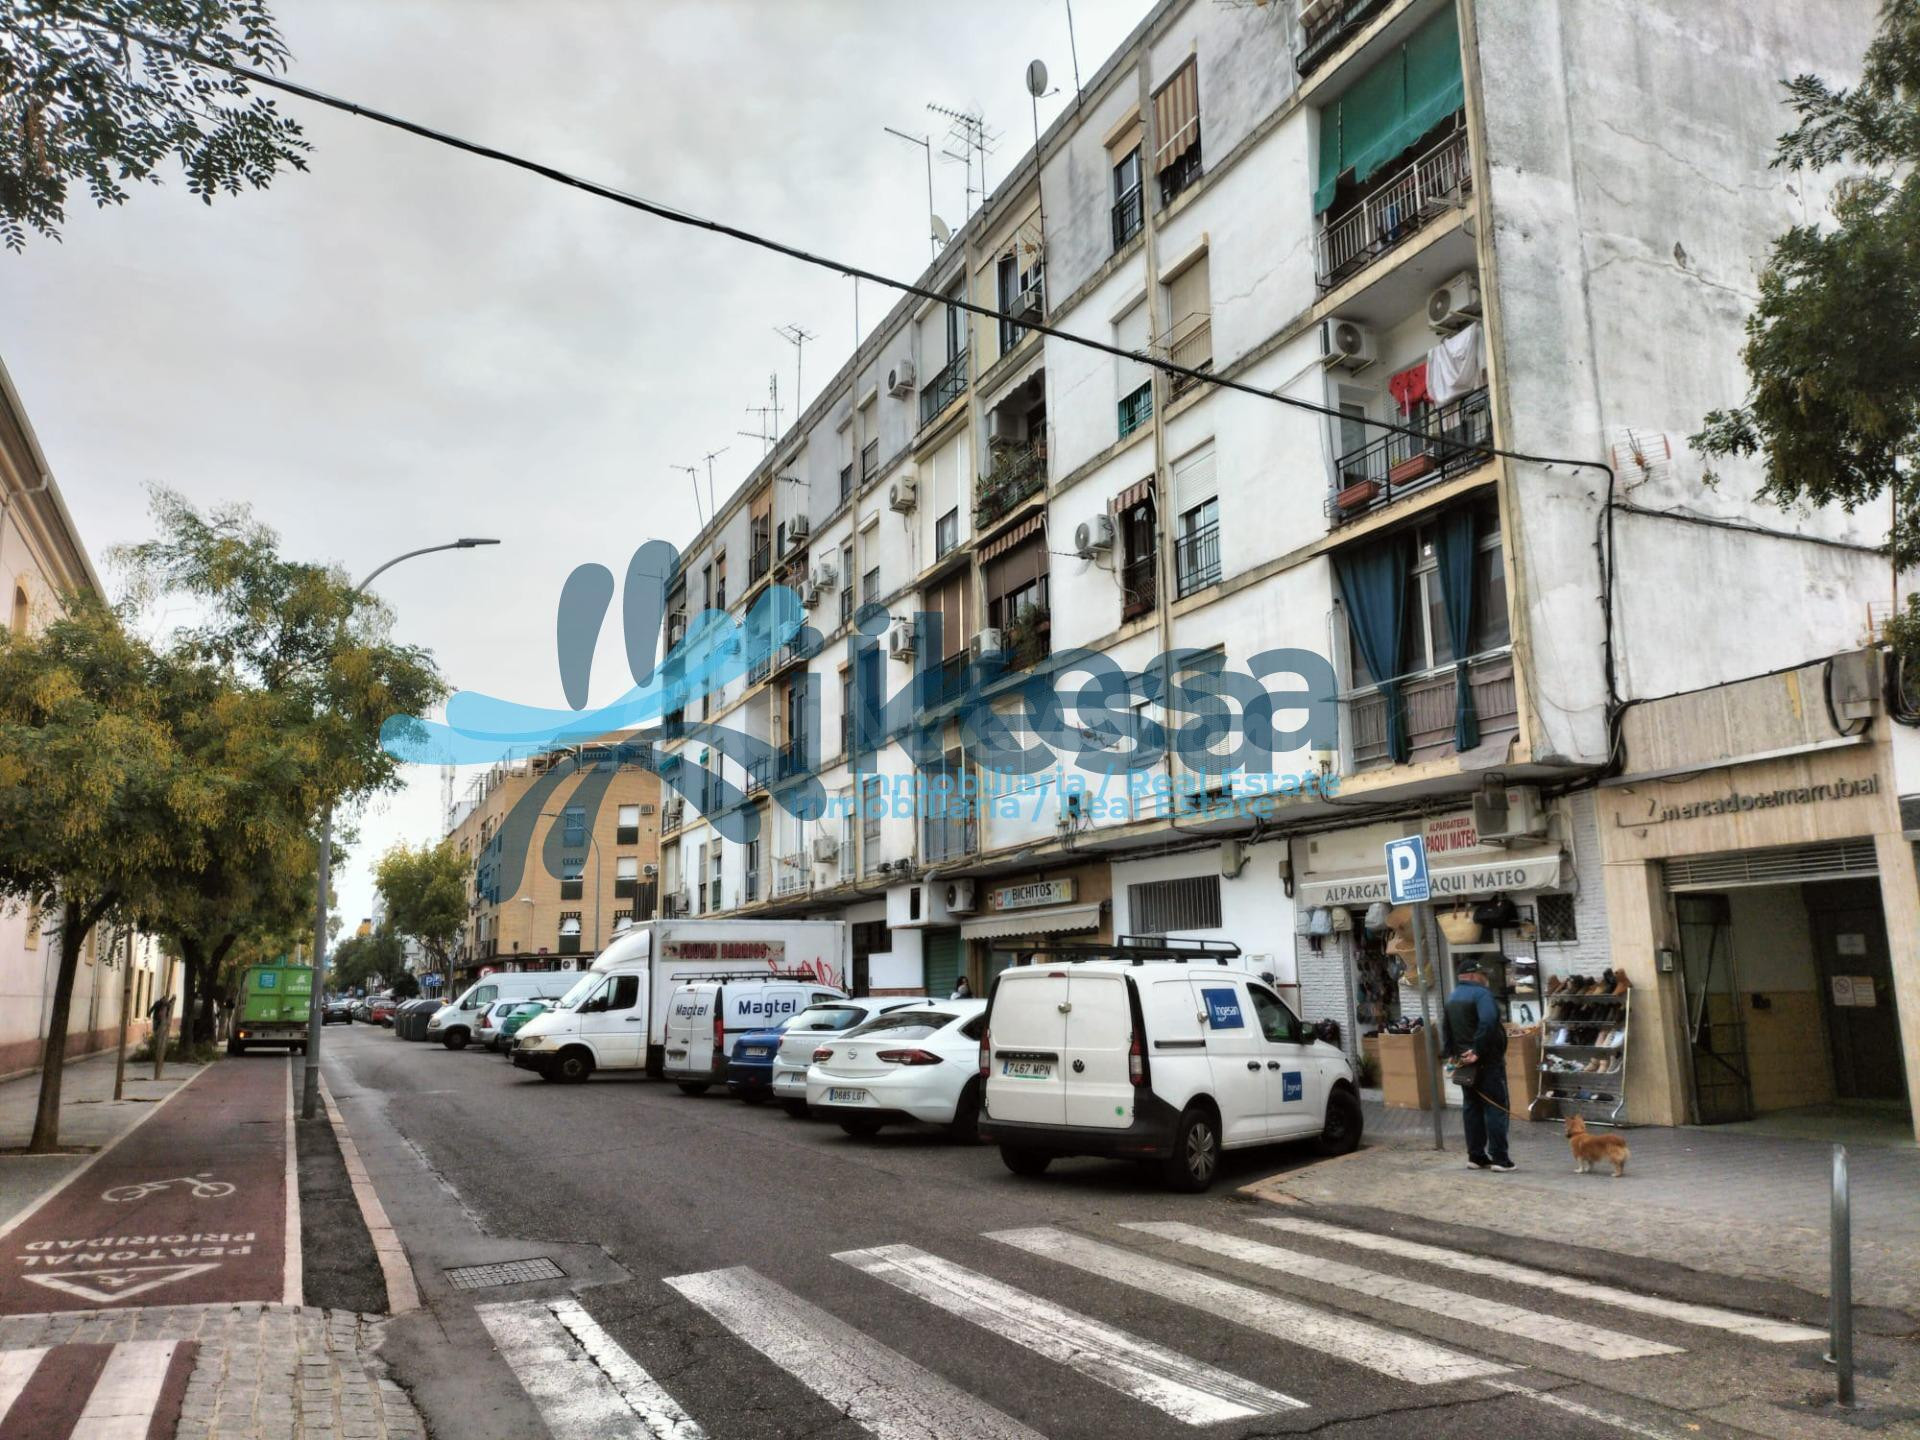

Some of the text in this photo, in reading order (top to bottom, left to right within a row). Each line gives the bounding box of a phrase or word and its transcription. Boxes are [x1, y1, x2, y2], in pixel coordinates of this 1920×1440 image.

[1429, 817, 1470, 832] ALPARGATERIA
[1426, 829, 1477, 853] PAQUI MATEO
[1392, 845, 1417, 898] P
[1012, 882, 1052, 901] BICHITOS
[1325, 883, 1387, 902] ALPARGAT
[1431, 875, 1467, 892] AQUI
[1473, 868, 1527, 889] MATEO
[675, 1004, 707, 1019] Magtel
[738, 999, 797, 1018] Magtel
[1008, 1063, 1052, 1076] 7467 MPN
[24, 1232, 256, 1251] PRIORIDAD
[16, 1245, 252, 1266] PEATONAL
